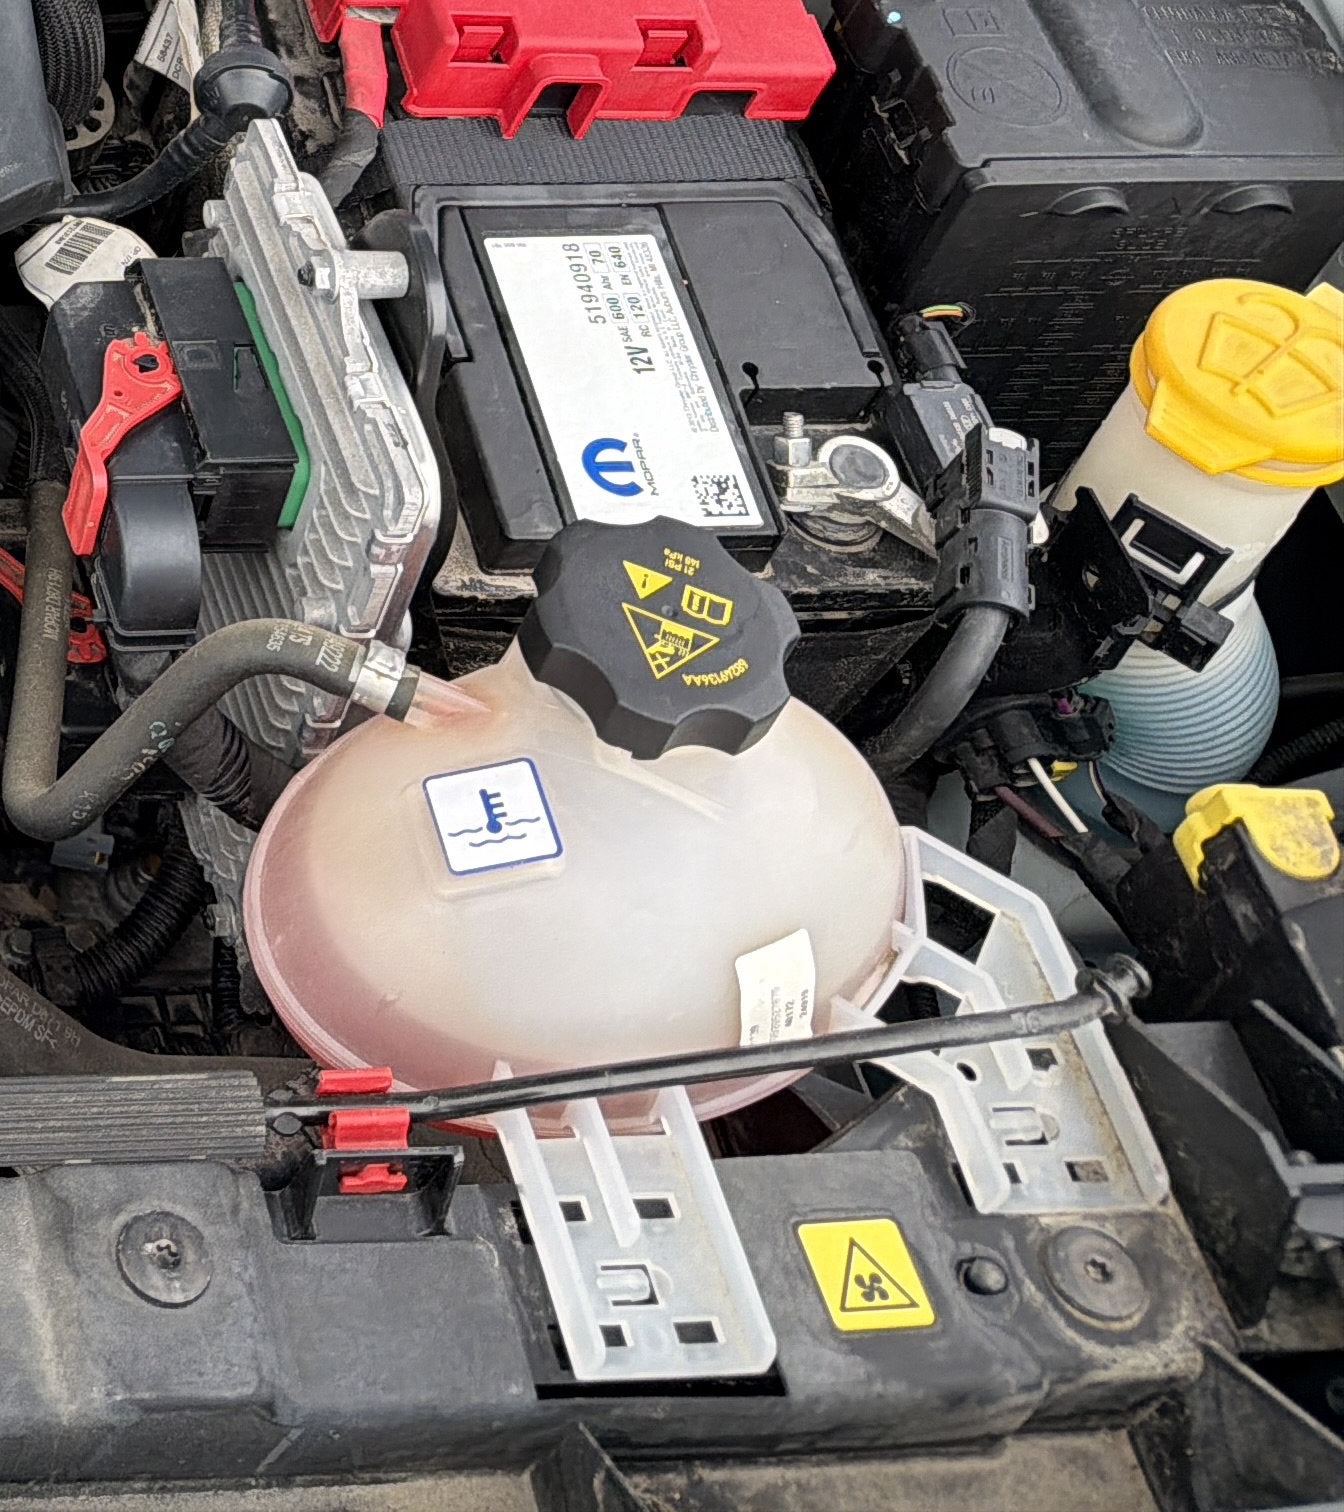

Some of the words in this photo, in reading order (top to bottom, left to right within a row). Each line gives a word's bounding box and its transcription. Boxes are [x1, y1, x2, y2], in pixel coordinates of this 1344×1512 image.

[589, 250, 605, 265] 70
[608, 246, 626, 268] 640
[562, 243, 607, 325] 51940918
[621, 274, 632, 286] EN
[607, 297, 625, 320] 600
[627, 296, 646, 320] 120
[617, 326, 633, 342] SAE
[639, 324, 652, 337] RC
[676, 332, 690, 352] Group
[624, 347, 656, 374] 12V
[696, 384, 706, 394] by
